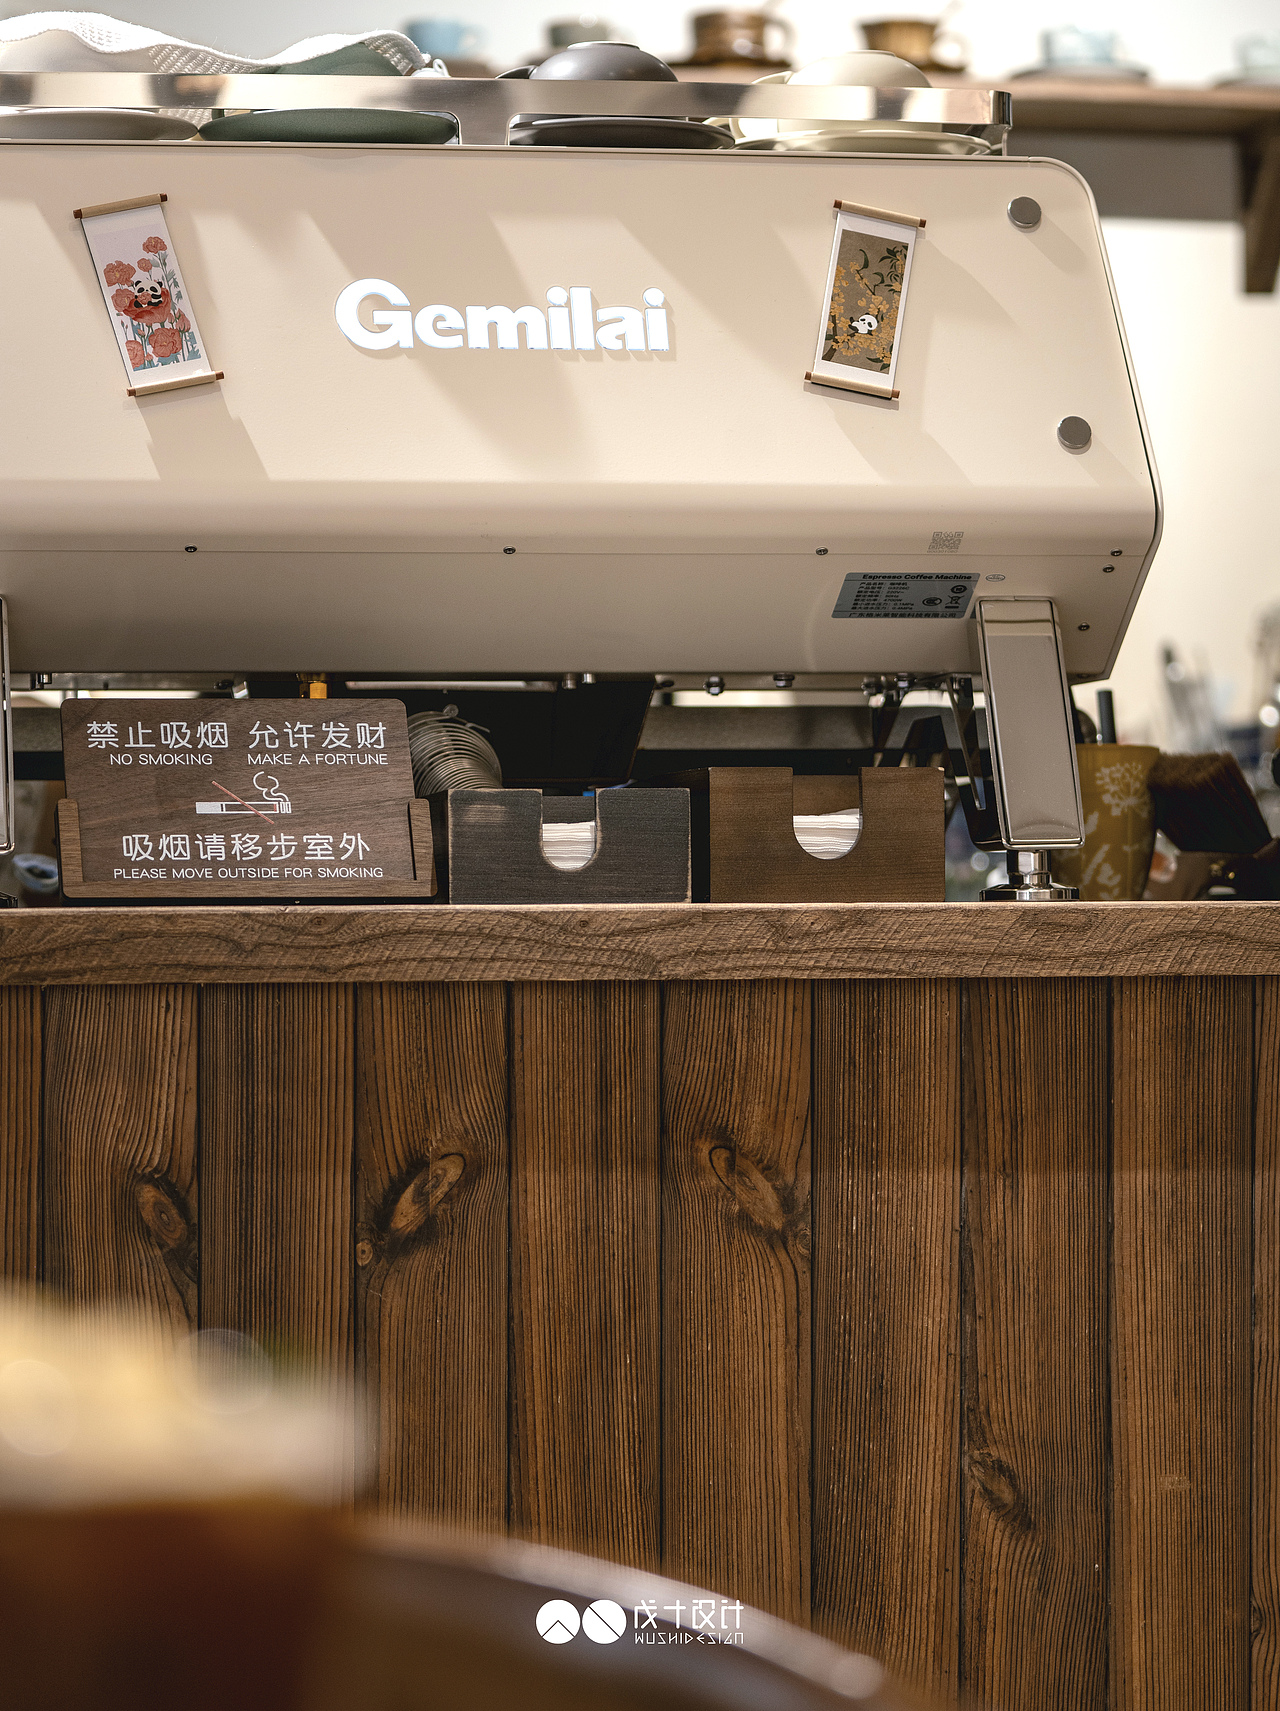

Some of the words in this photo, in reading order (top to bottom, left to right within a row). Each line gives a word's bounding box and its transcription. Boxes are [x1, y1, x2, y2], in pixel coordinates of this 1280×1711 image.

[334, 277, 670, 352] Gemilai
[86, 721, 229, 749] 禁止吸烟
[248, 720, 387, 750] 允许发财
[109, 753, 132, 766] NO
[138, 753, 213, 766] SMOKING
[247, 753, 292, 765] MAKE
[298, 753, 311, 765] A
[316, 753, 388, 765] FORTUNE
[122, 832, 370, 861] 吸烟请移步室外
[113, 867, 167, 879] PLEASE
[172, 867, 213, 879] MOVE
[218, 867, 280, 878] OUTSIDE
[284, 867, 312, 878] FOR
[317, 867, 383, 878] SMOKING
